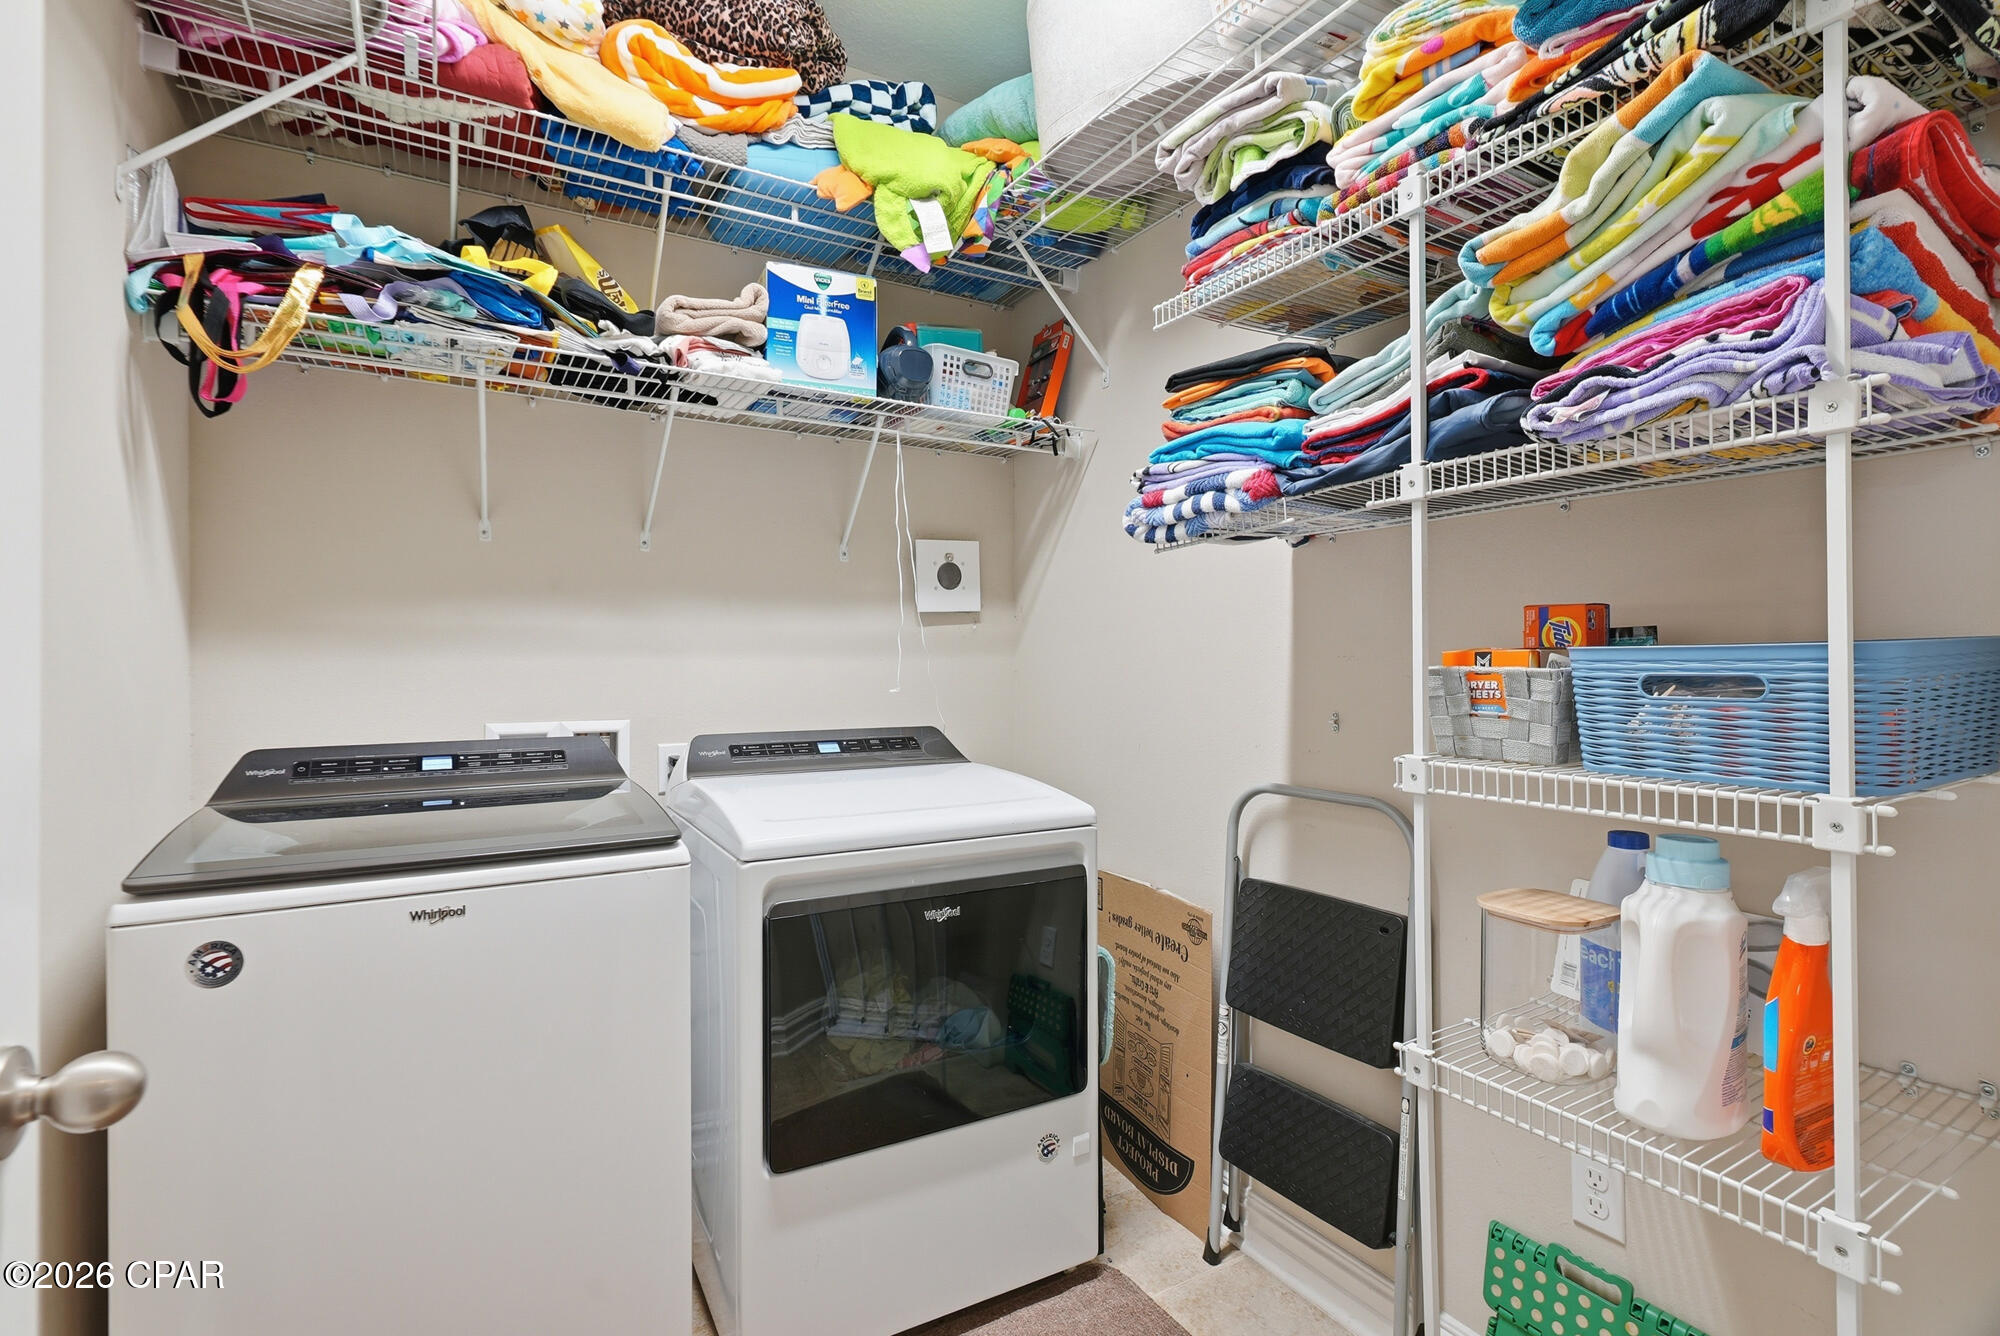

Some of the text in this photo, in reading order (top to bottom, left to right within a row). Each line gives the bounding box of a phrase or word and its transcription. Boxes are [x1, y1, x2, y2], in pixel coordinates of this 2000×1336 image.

[796, 294, 814, 305] Mini
[1548, 619, 1573, 647] Tide
[1470, 689, 1502, 699] HEETS
[409, 905, 466, 924] Whirlpool
[924, 905, 961, 922] Whirlpool
[1134, 922, 1154, 943] better
[1154, 932, 1189, 963] Create
[1581, 945, 1614, 970] each
[1104, 1105, 1135, 1139] BOARD
[1117, 1135, 1159, 1183] PROJECT
[1136, 1132, 1179, 1178] DISPLAY
